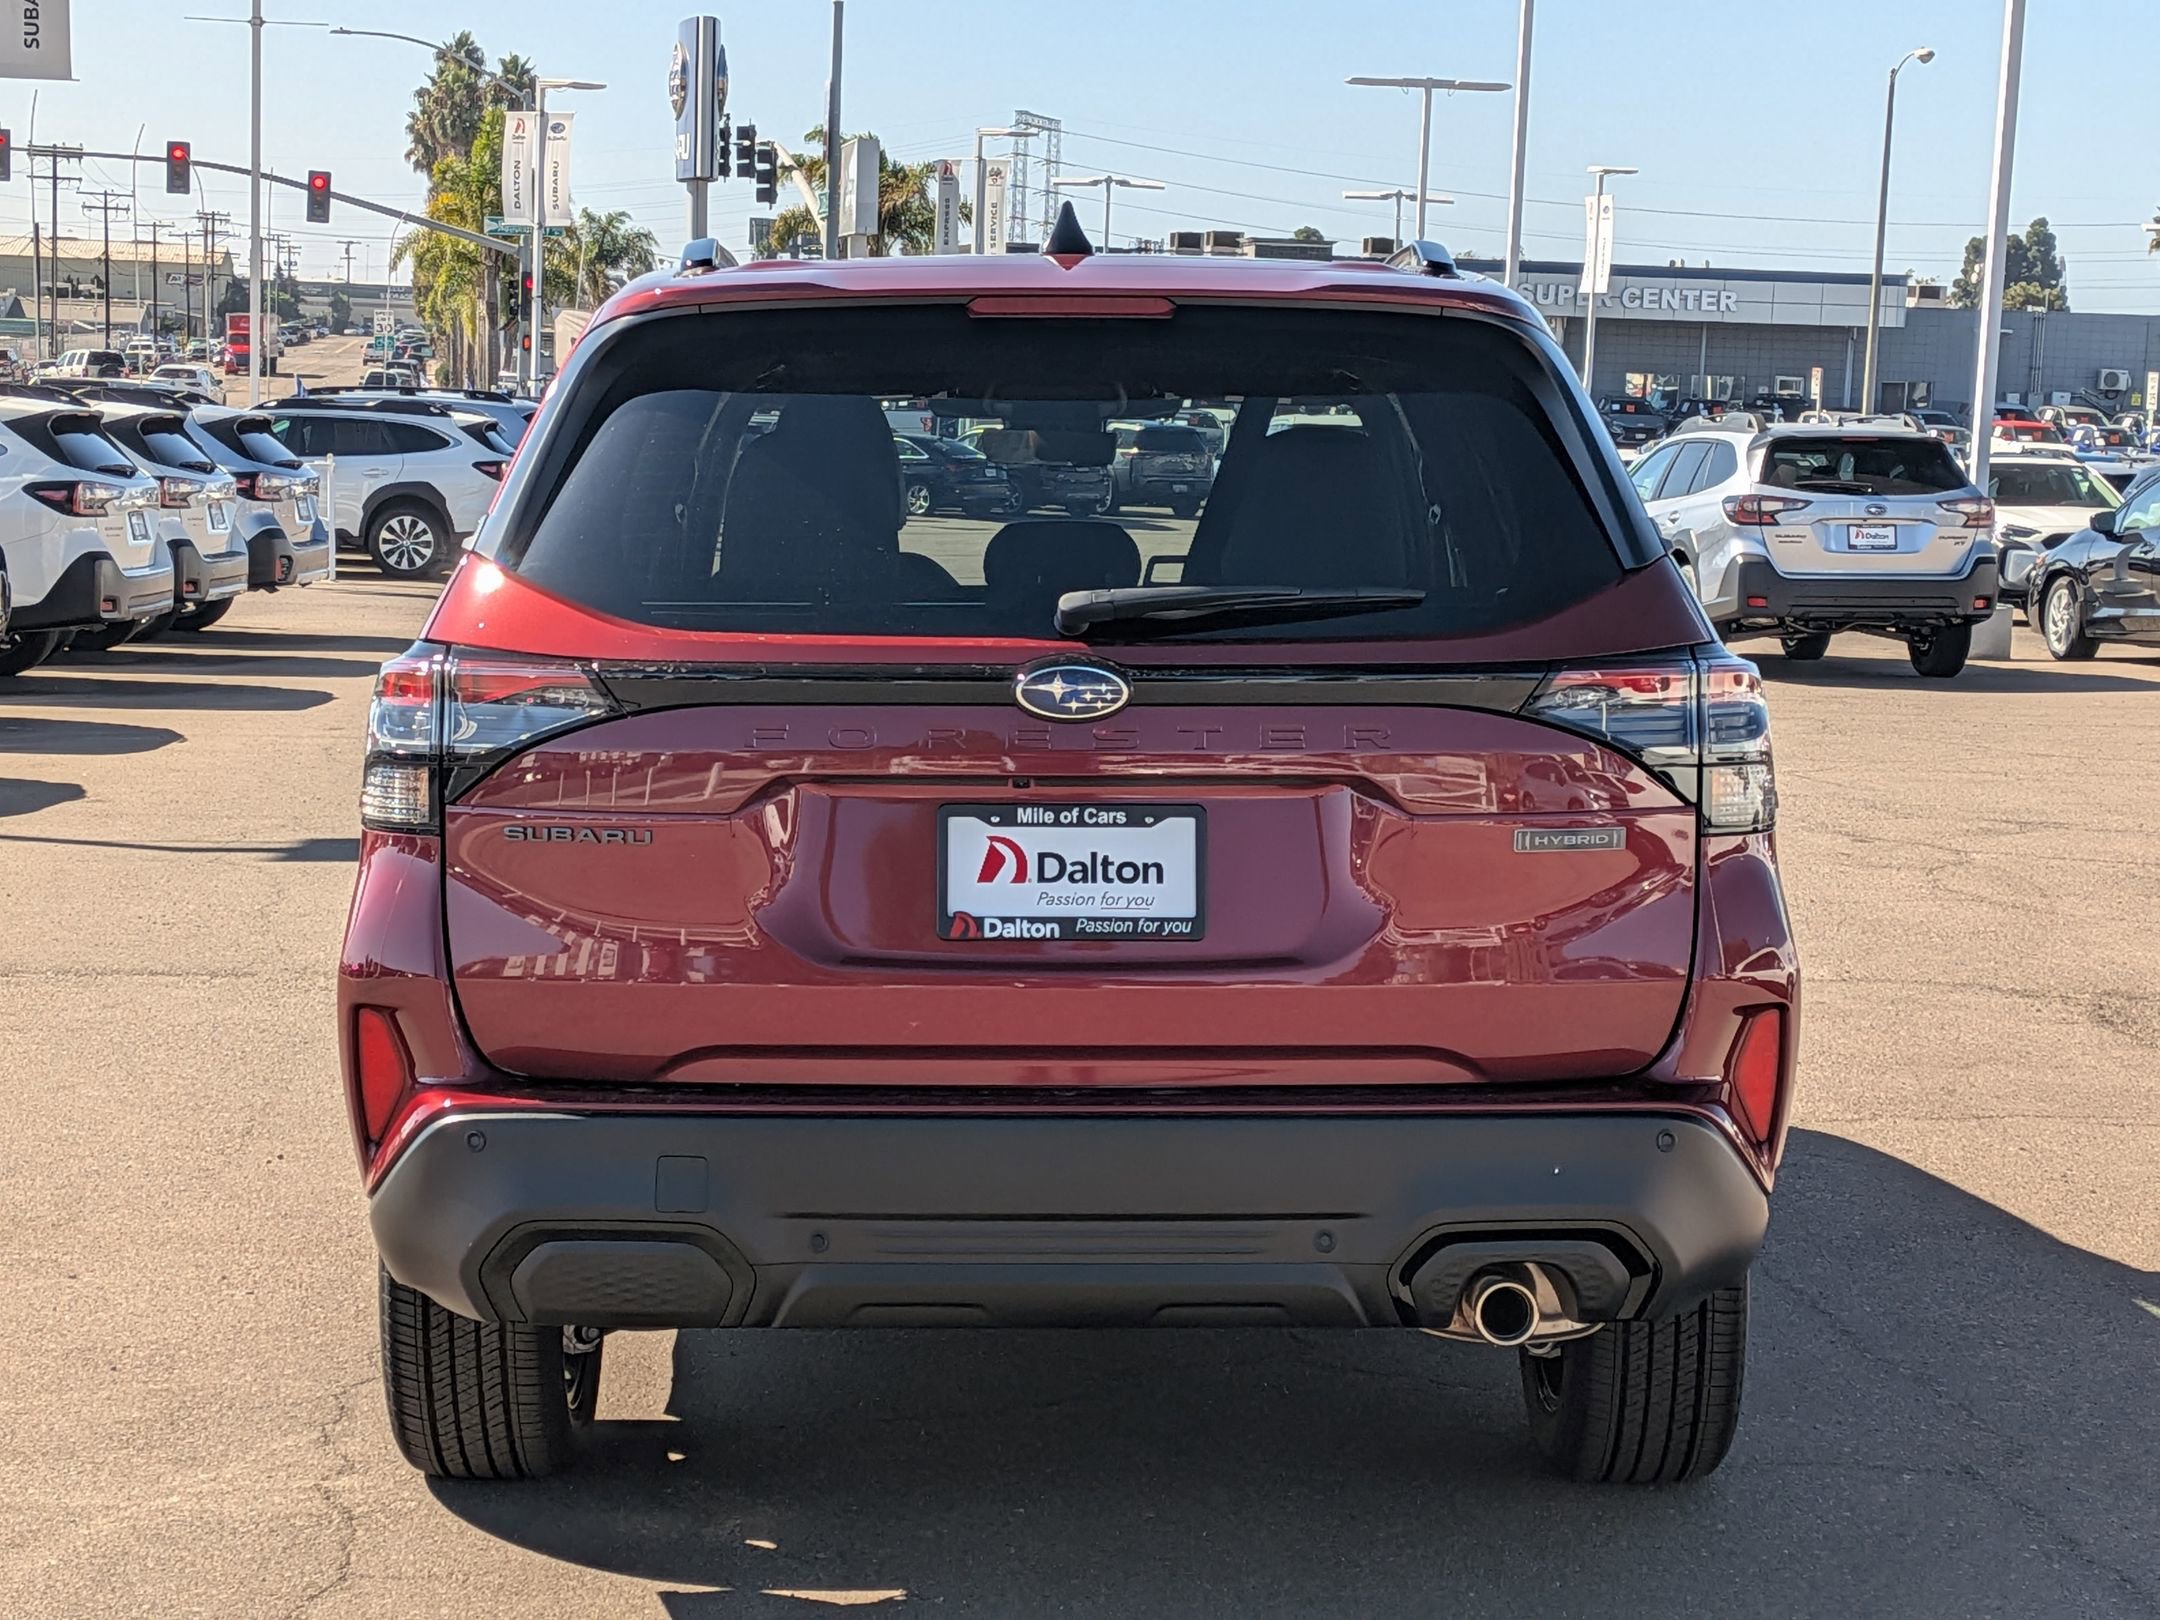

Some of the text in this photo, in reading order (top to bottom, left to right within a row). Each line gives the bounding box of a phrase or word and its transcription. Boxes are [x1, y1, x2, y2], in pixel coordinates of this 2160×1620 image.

[1622, 287, 1738, 312] CENTER
[376, 323, 393, 333] 30
[745, 724, 1391, 750] FORESTER
[1017, 808, 1127, 824] Mile of Cars
[503, 826, 653, 846] SUBARU
[1534, 834, 1609, 846] HYBRID
[1037, 852, 1164, 884] Dalton
[1036, 892, 1155, 909] Passion for you
[983, 918, 1192, 938] Dalton Passion for you
